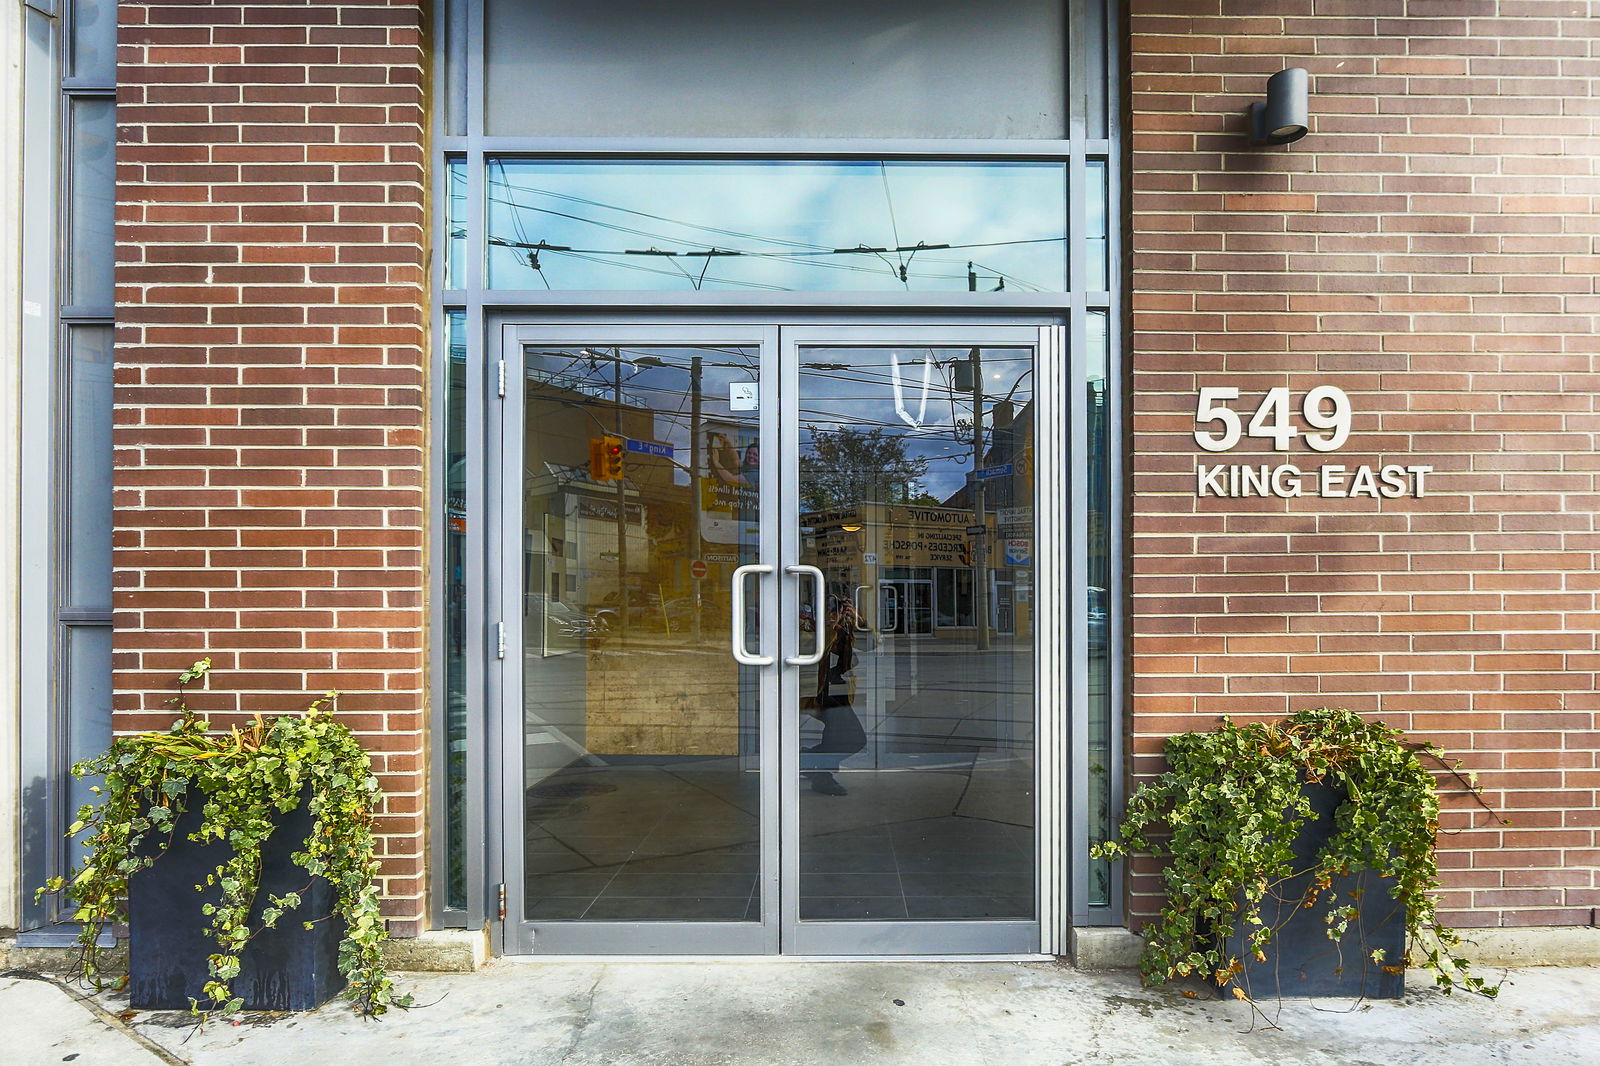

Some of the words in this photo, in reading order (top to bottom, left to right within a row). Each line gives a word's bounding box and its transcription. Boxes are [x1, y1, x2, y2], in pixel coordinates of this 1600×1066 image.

[1194, 385, 1351, 452] 549
[1198, 464, 1301, 498] KING
[1321, 464, 1433, 498] EAST
